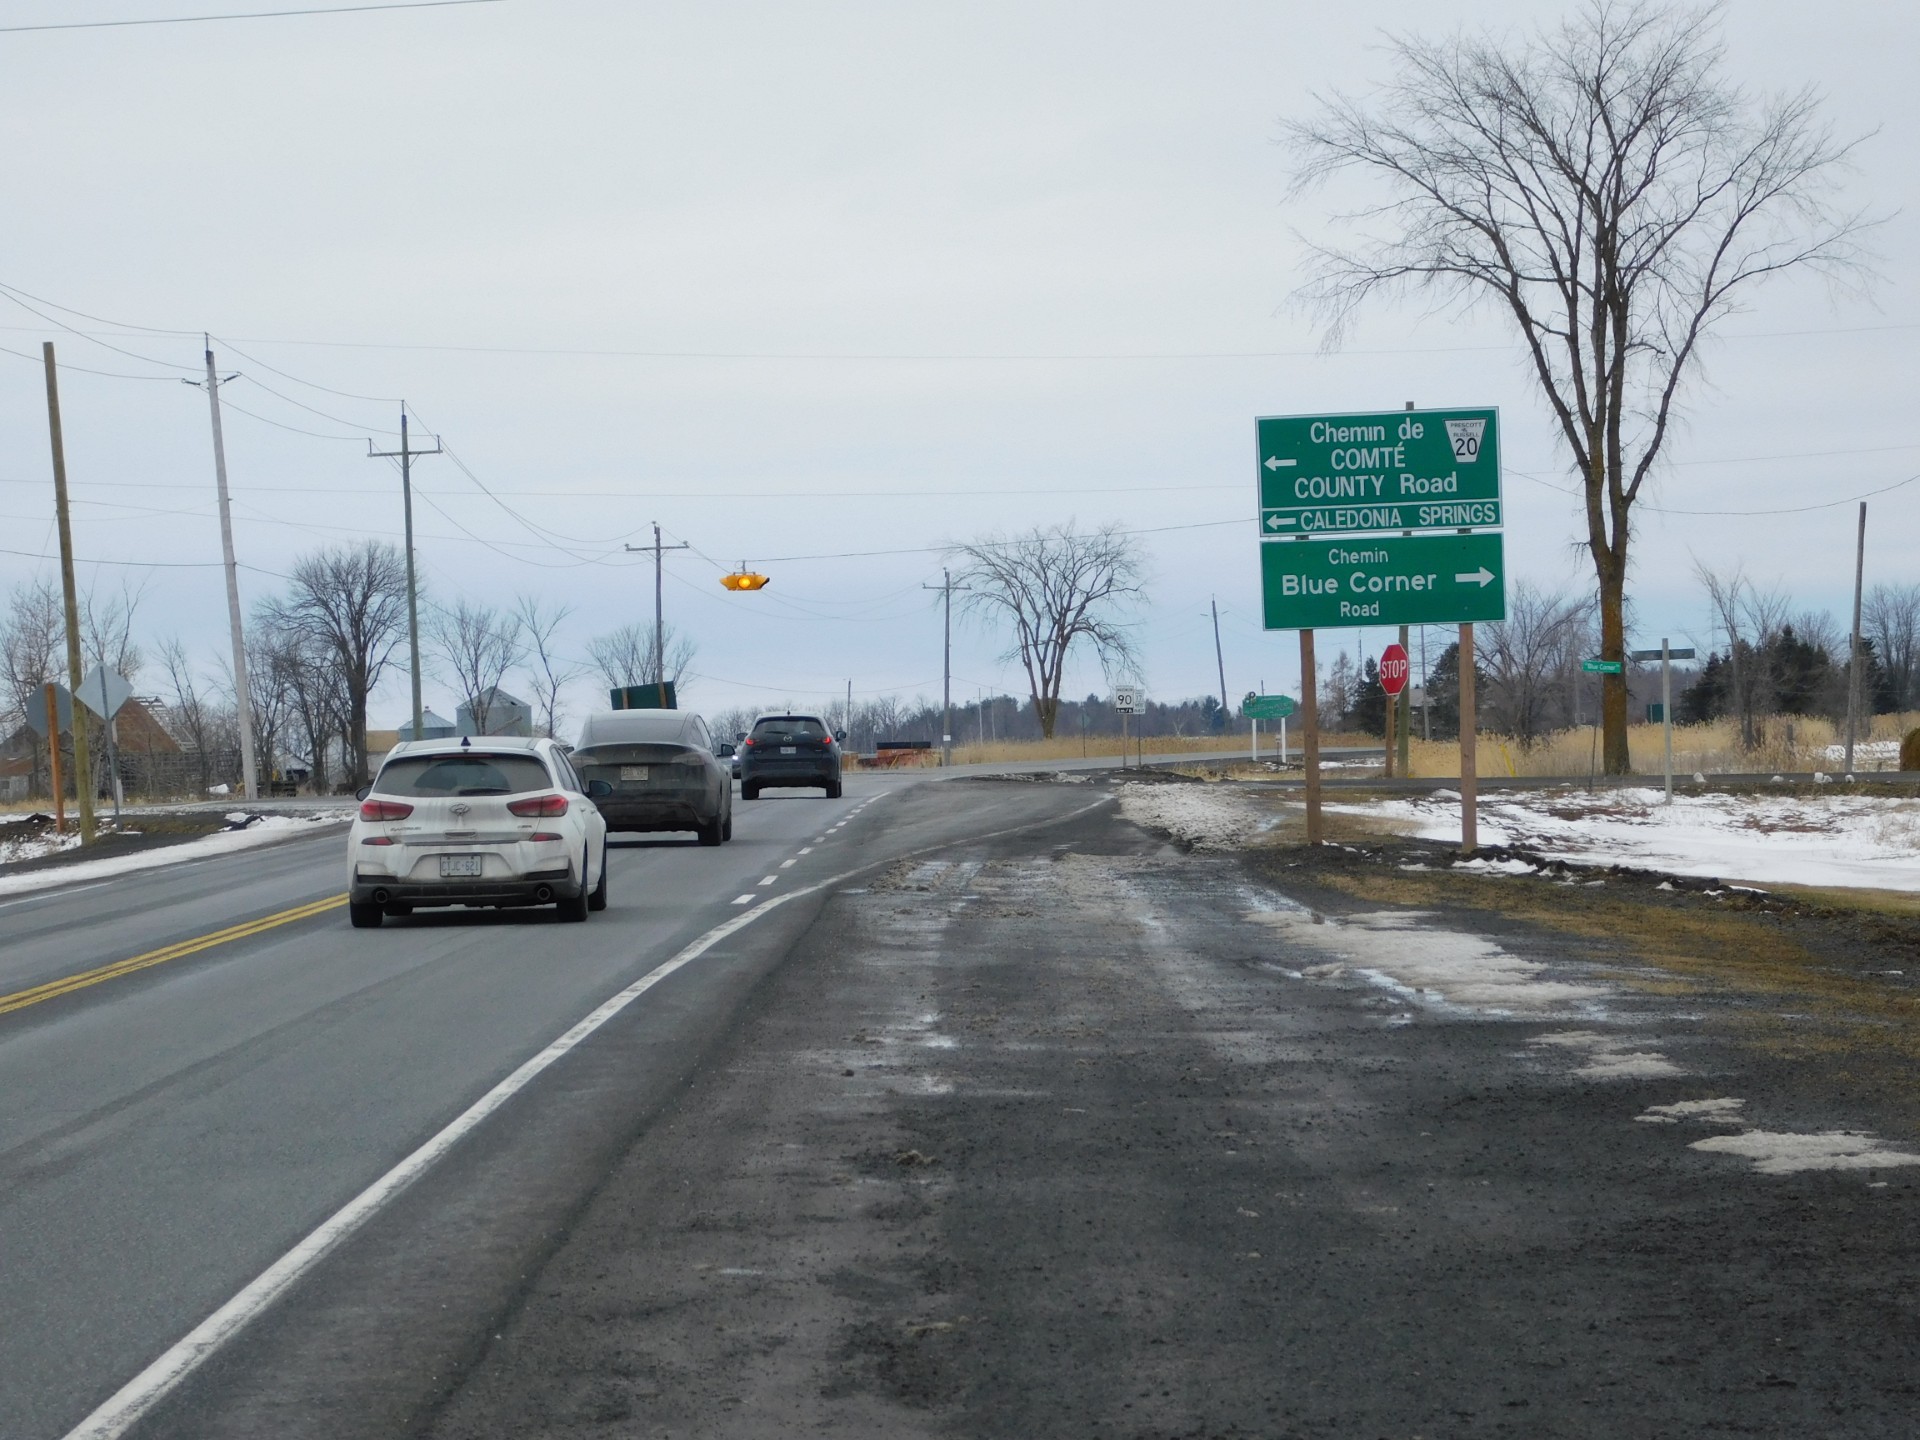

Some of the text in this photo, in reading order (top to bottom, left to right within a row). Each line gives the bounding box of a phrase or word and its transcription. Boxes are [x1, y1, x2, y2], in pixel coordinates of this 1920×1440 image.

[1310, 417, 1424, 444] Chemin de
[1331, 442, 1406, 470] COMTÉ
[1456, 438, 1477, 456] 20
[1294, 471, 1457, 499] COUNTY Road
[1300, 503, 1496, 531] CALEDONIA SPRINGS
[1328, 548, 1388, 565] Chemin
[1282, 572, 1436, 596] Blue Corner
[1340, 601, 1380, 617] Road
[1382, 660, 1406, 679] STOP
[1118, 695, 1132, 705] 90
